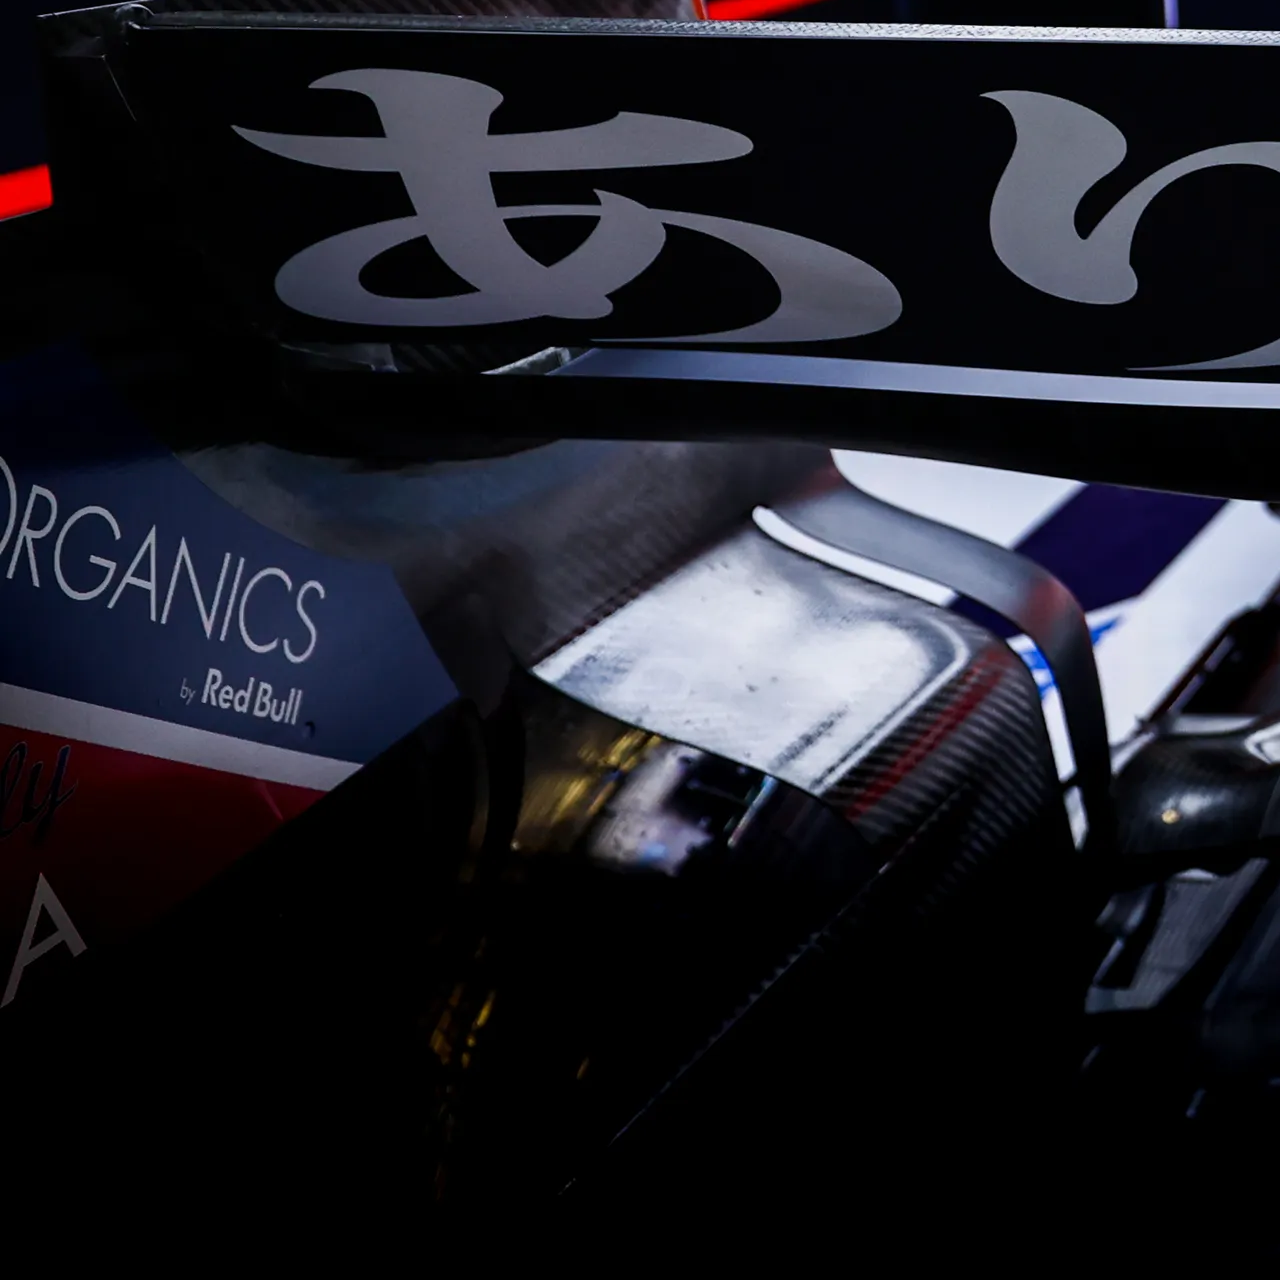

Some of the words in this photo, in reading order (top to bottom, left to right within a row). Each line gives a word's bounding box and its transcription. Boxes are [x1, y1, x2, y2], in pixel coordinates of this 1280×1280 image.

[179, 677, 197, 706] by
[201, 667, 255, 714] Red
[252, 677, 304, 726] Bull
